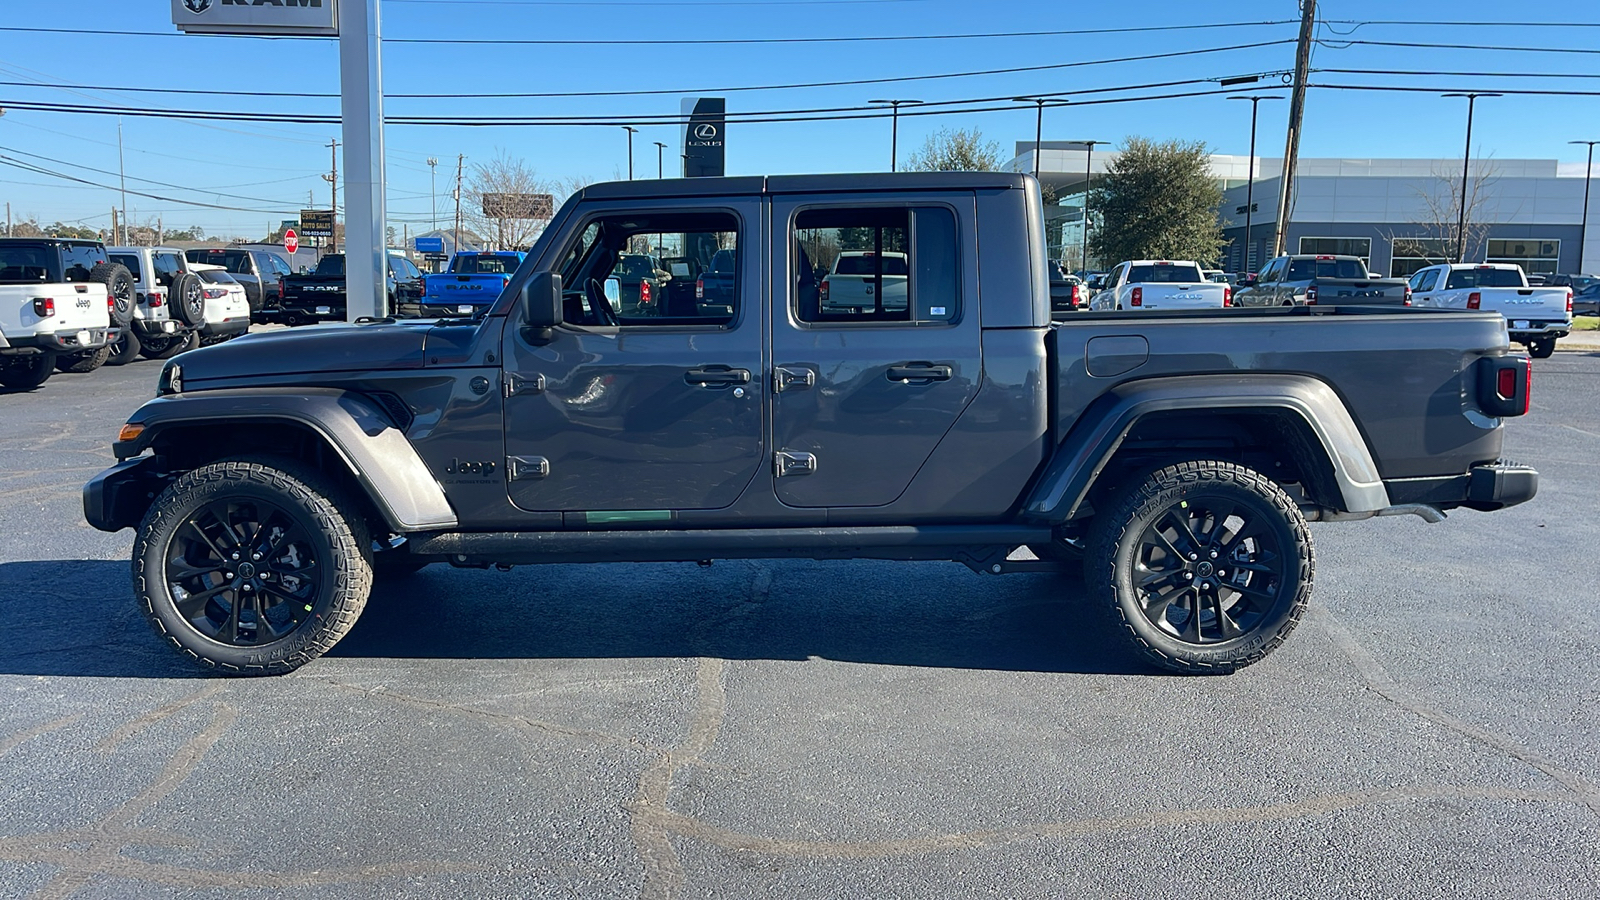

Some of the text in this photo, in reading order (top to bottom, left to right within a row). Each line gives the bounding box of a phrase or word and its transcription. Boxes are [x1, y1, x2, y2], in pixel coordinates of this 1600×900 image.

[286, 237, 297, 246] STOP
[76, 298, 91, 309] Jeep
[445, 458, 496, 477] Jeep
[1176, 634, 1264, 662] GENERAL
